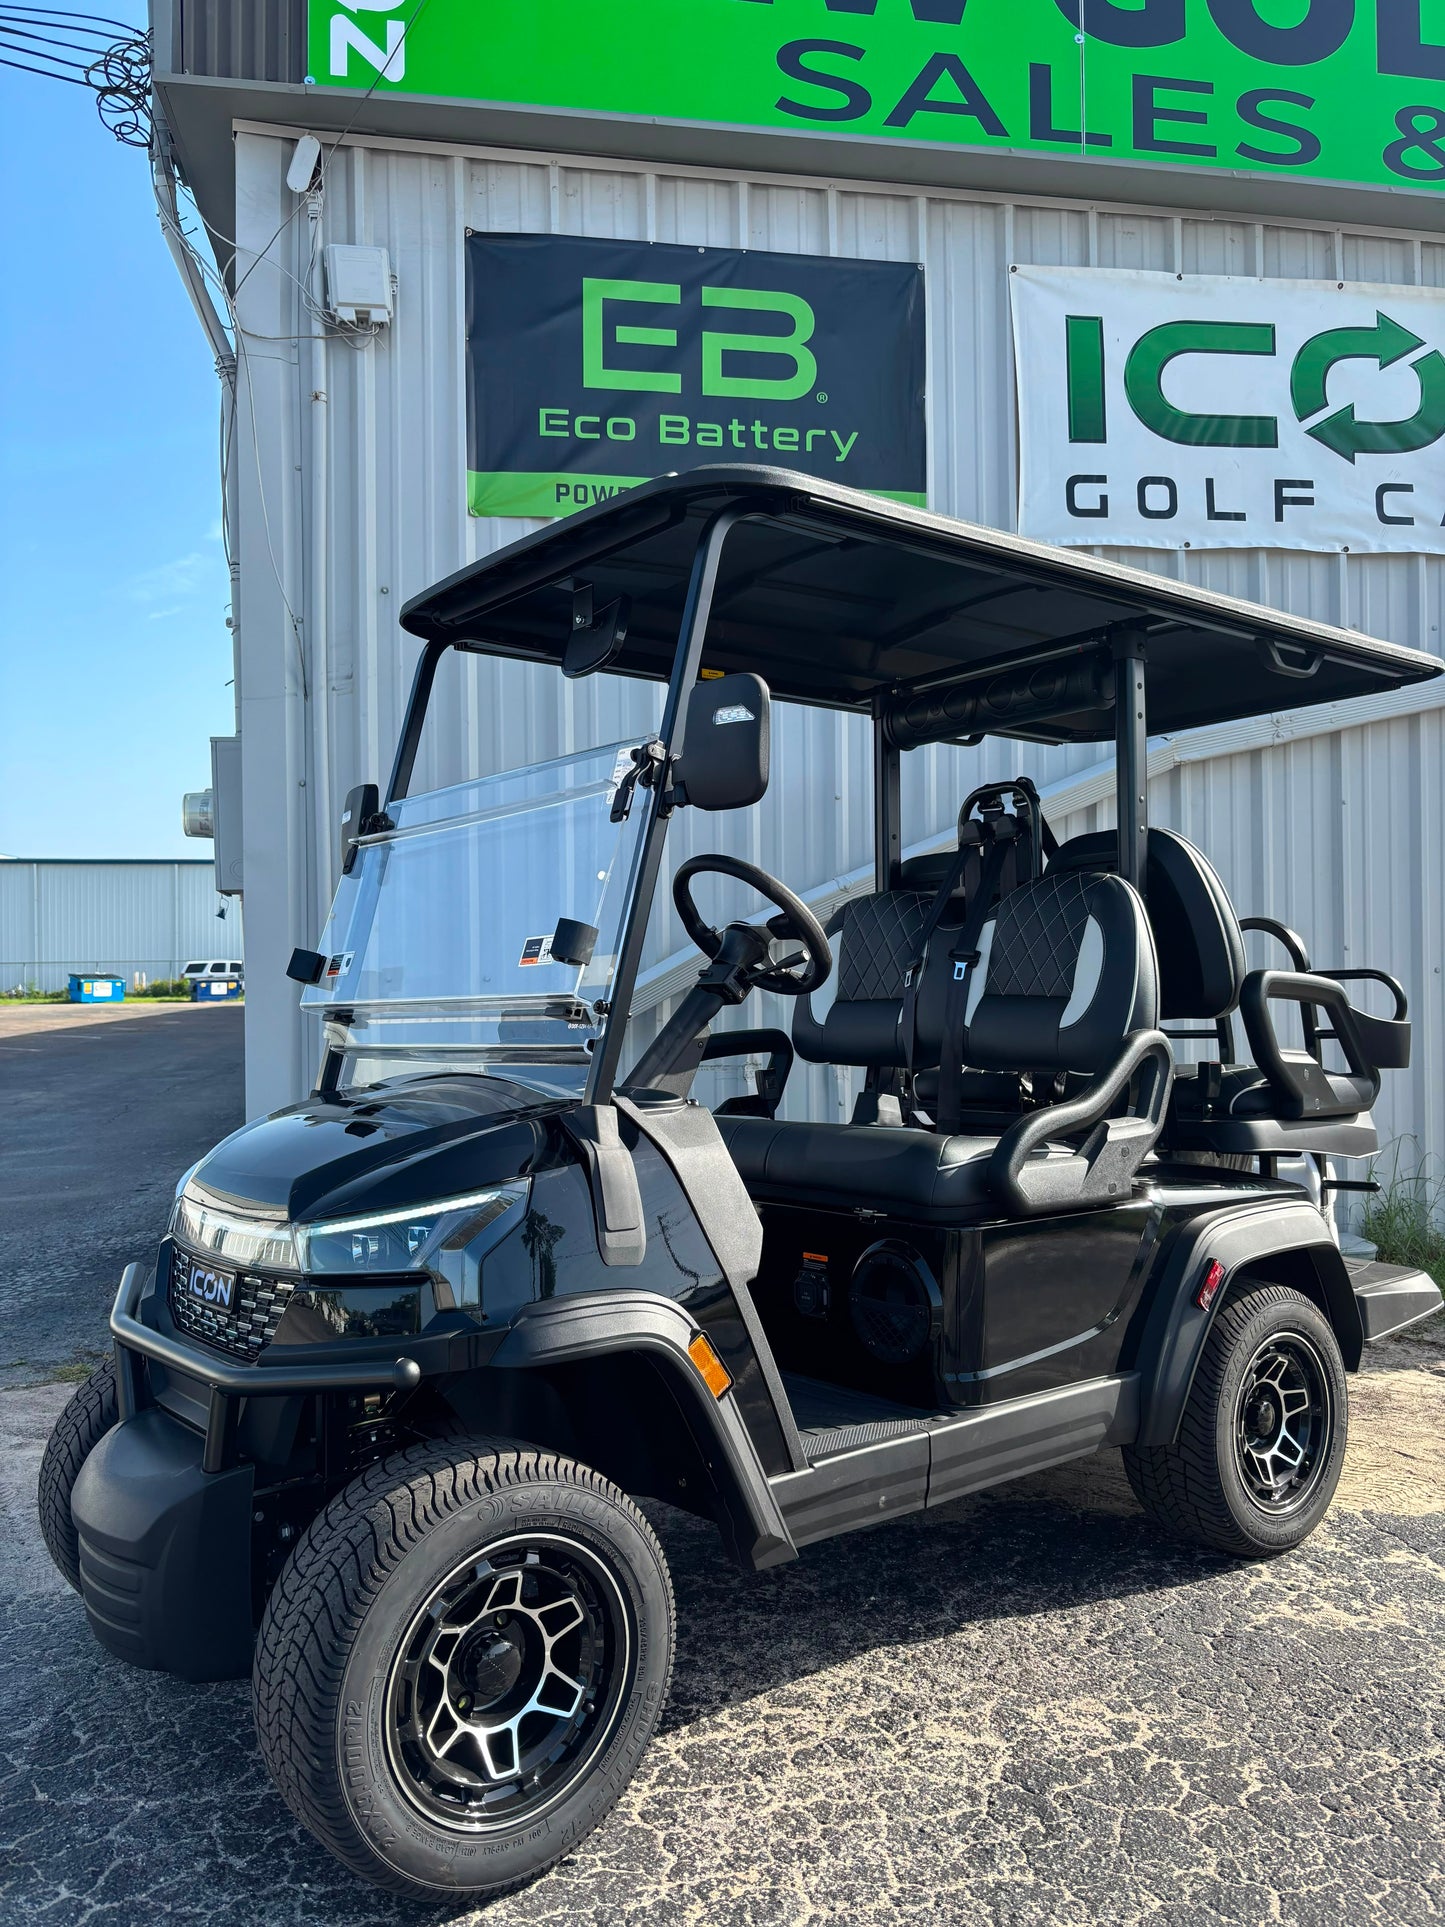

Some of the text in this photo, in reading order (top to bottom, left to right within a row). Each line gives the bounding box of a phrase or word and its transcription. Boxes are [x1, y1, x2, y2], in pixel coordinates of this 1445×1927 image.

[774, 38, 1322, 166] SALES
[582, 277, 818, 401] EB
[539, 408, 859, 462] Eco Battery
[555, 483, 633, 504] POW
[1065, 474, 1445, 527] GOLF C
[189, 1265, 232, 1306] ICON
